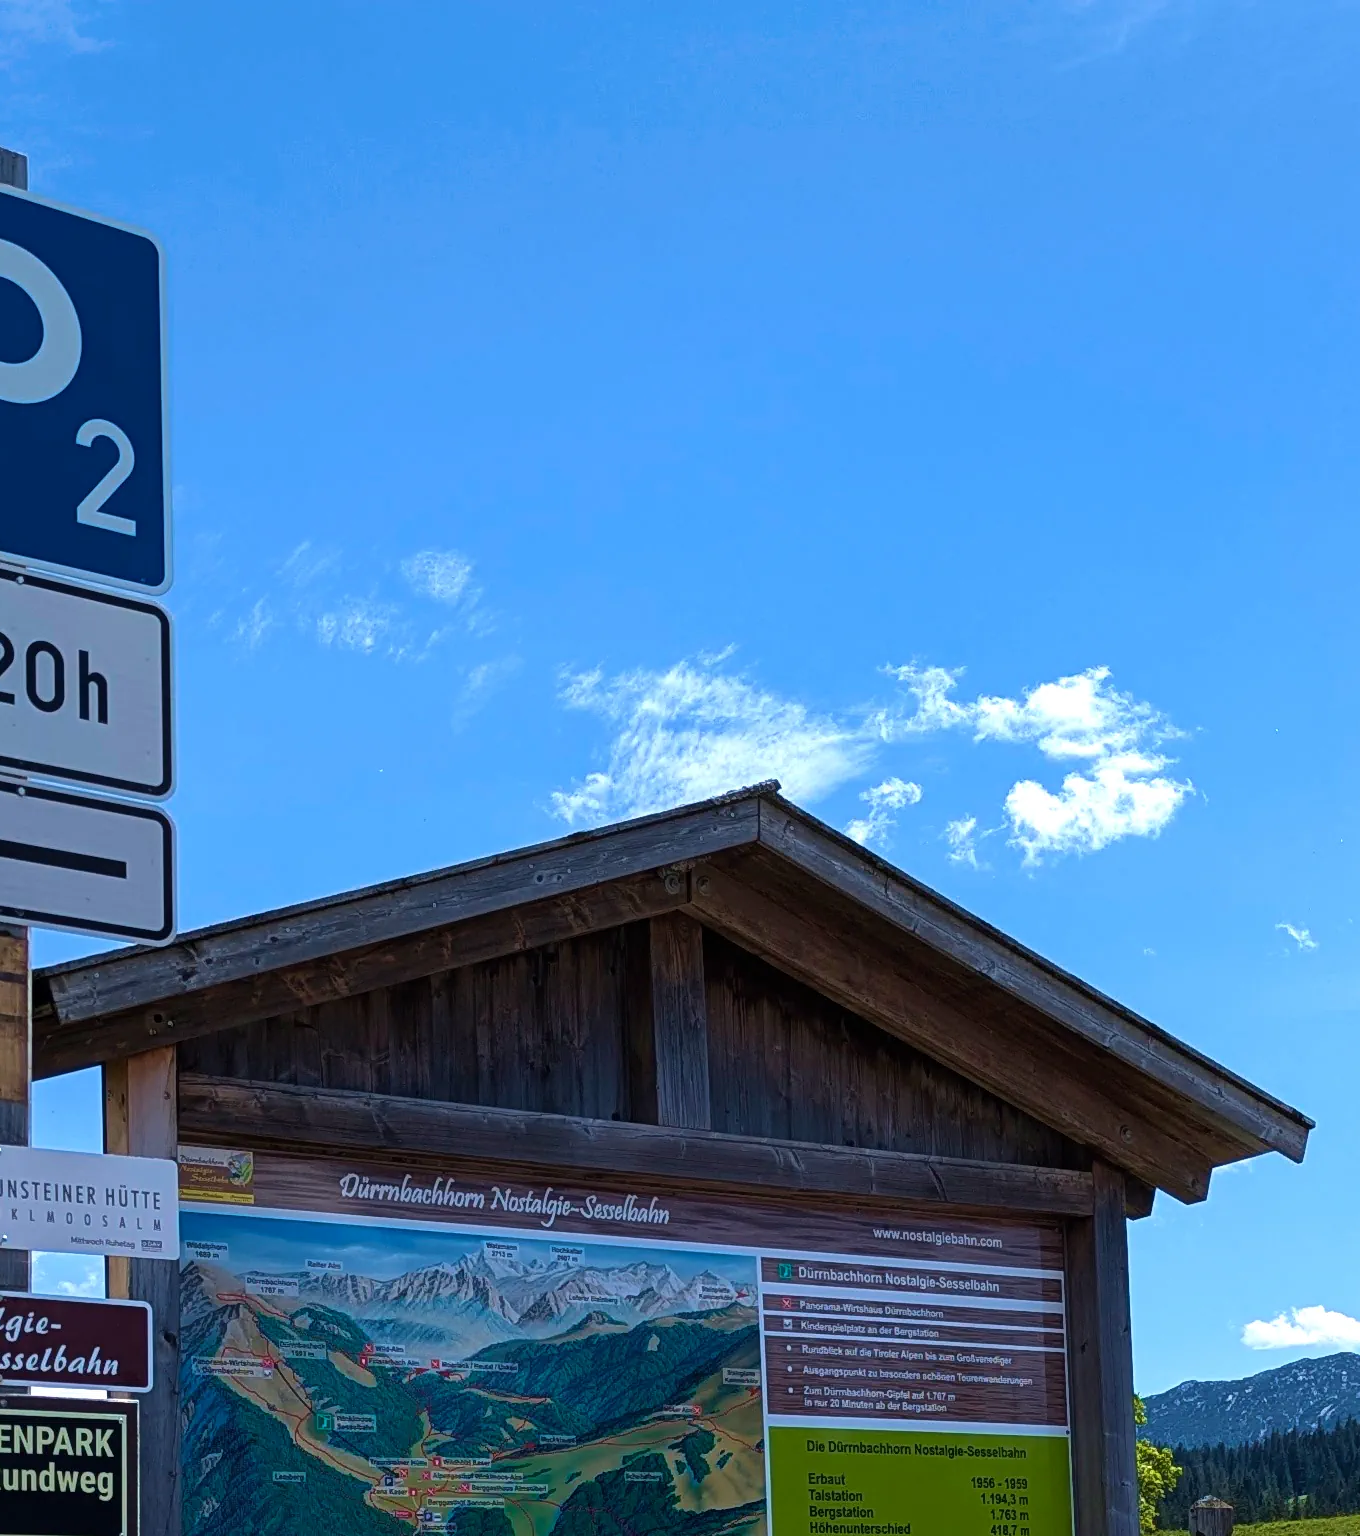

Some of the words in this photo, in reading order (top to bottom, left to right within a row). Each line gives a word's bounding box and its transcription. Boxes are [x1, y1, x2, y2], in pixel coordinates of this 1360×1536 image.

[75, 418, 137, 537] 2
[104, 1183, 161, 1211] HÜTTE
[340, 1172, 484, 1210] Dürrnbachhorn
[489, 1186, 671, 1228] Nostalgie-Sesselbahn
[71, 1237, 104, 1246] Mittwoch
[873, 1227, 1002, 1249] www.nostalgiebahn.com
[799, 1266, 882, 1284] Dürrnbachhorn
[885, 1273, 1000, 1293] Nostalgie-Sesselbahn
[800, 1300, 883, 1316] Panorama-Wirtshaus
[867, 1327, 877, 1335] an
[878, 1326, 892, 1336] der
[894, 1326, 939, 1339] Bergstation
[901, 1350, 923, 1361] Alpen
[804, 1386, 821, 1396] Zum
[807, 1439, 825, 1452] Die
[828, 1440, 911, 1455] Dürrnbachhorn
[914, 1444, 1027, 1459] Nostalgie-Sesselbahn
[808, 1472, 845, 1485] Erbaut
[971, 1477, 995, 1489] 1956
[809, 1489, 863, 1502] Talstation
[980, 1494, 1017, 1506] 1.194,3
[1019, 1496, 1028, 1505] m
[809, 1506, 874, 1519] Bergstation
[1019, 1512, 1029, 1521] m
[809, 1522, 911, 1535] Höhenunterschied
[1020, 1527, 1030, 1536] m
